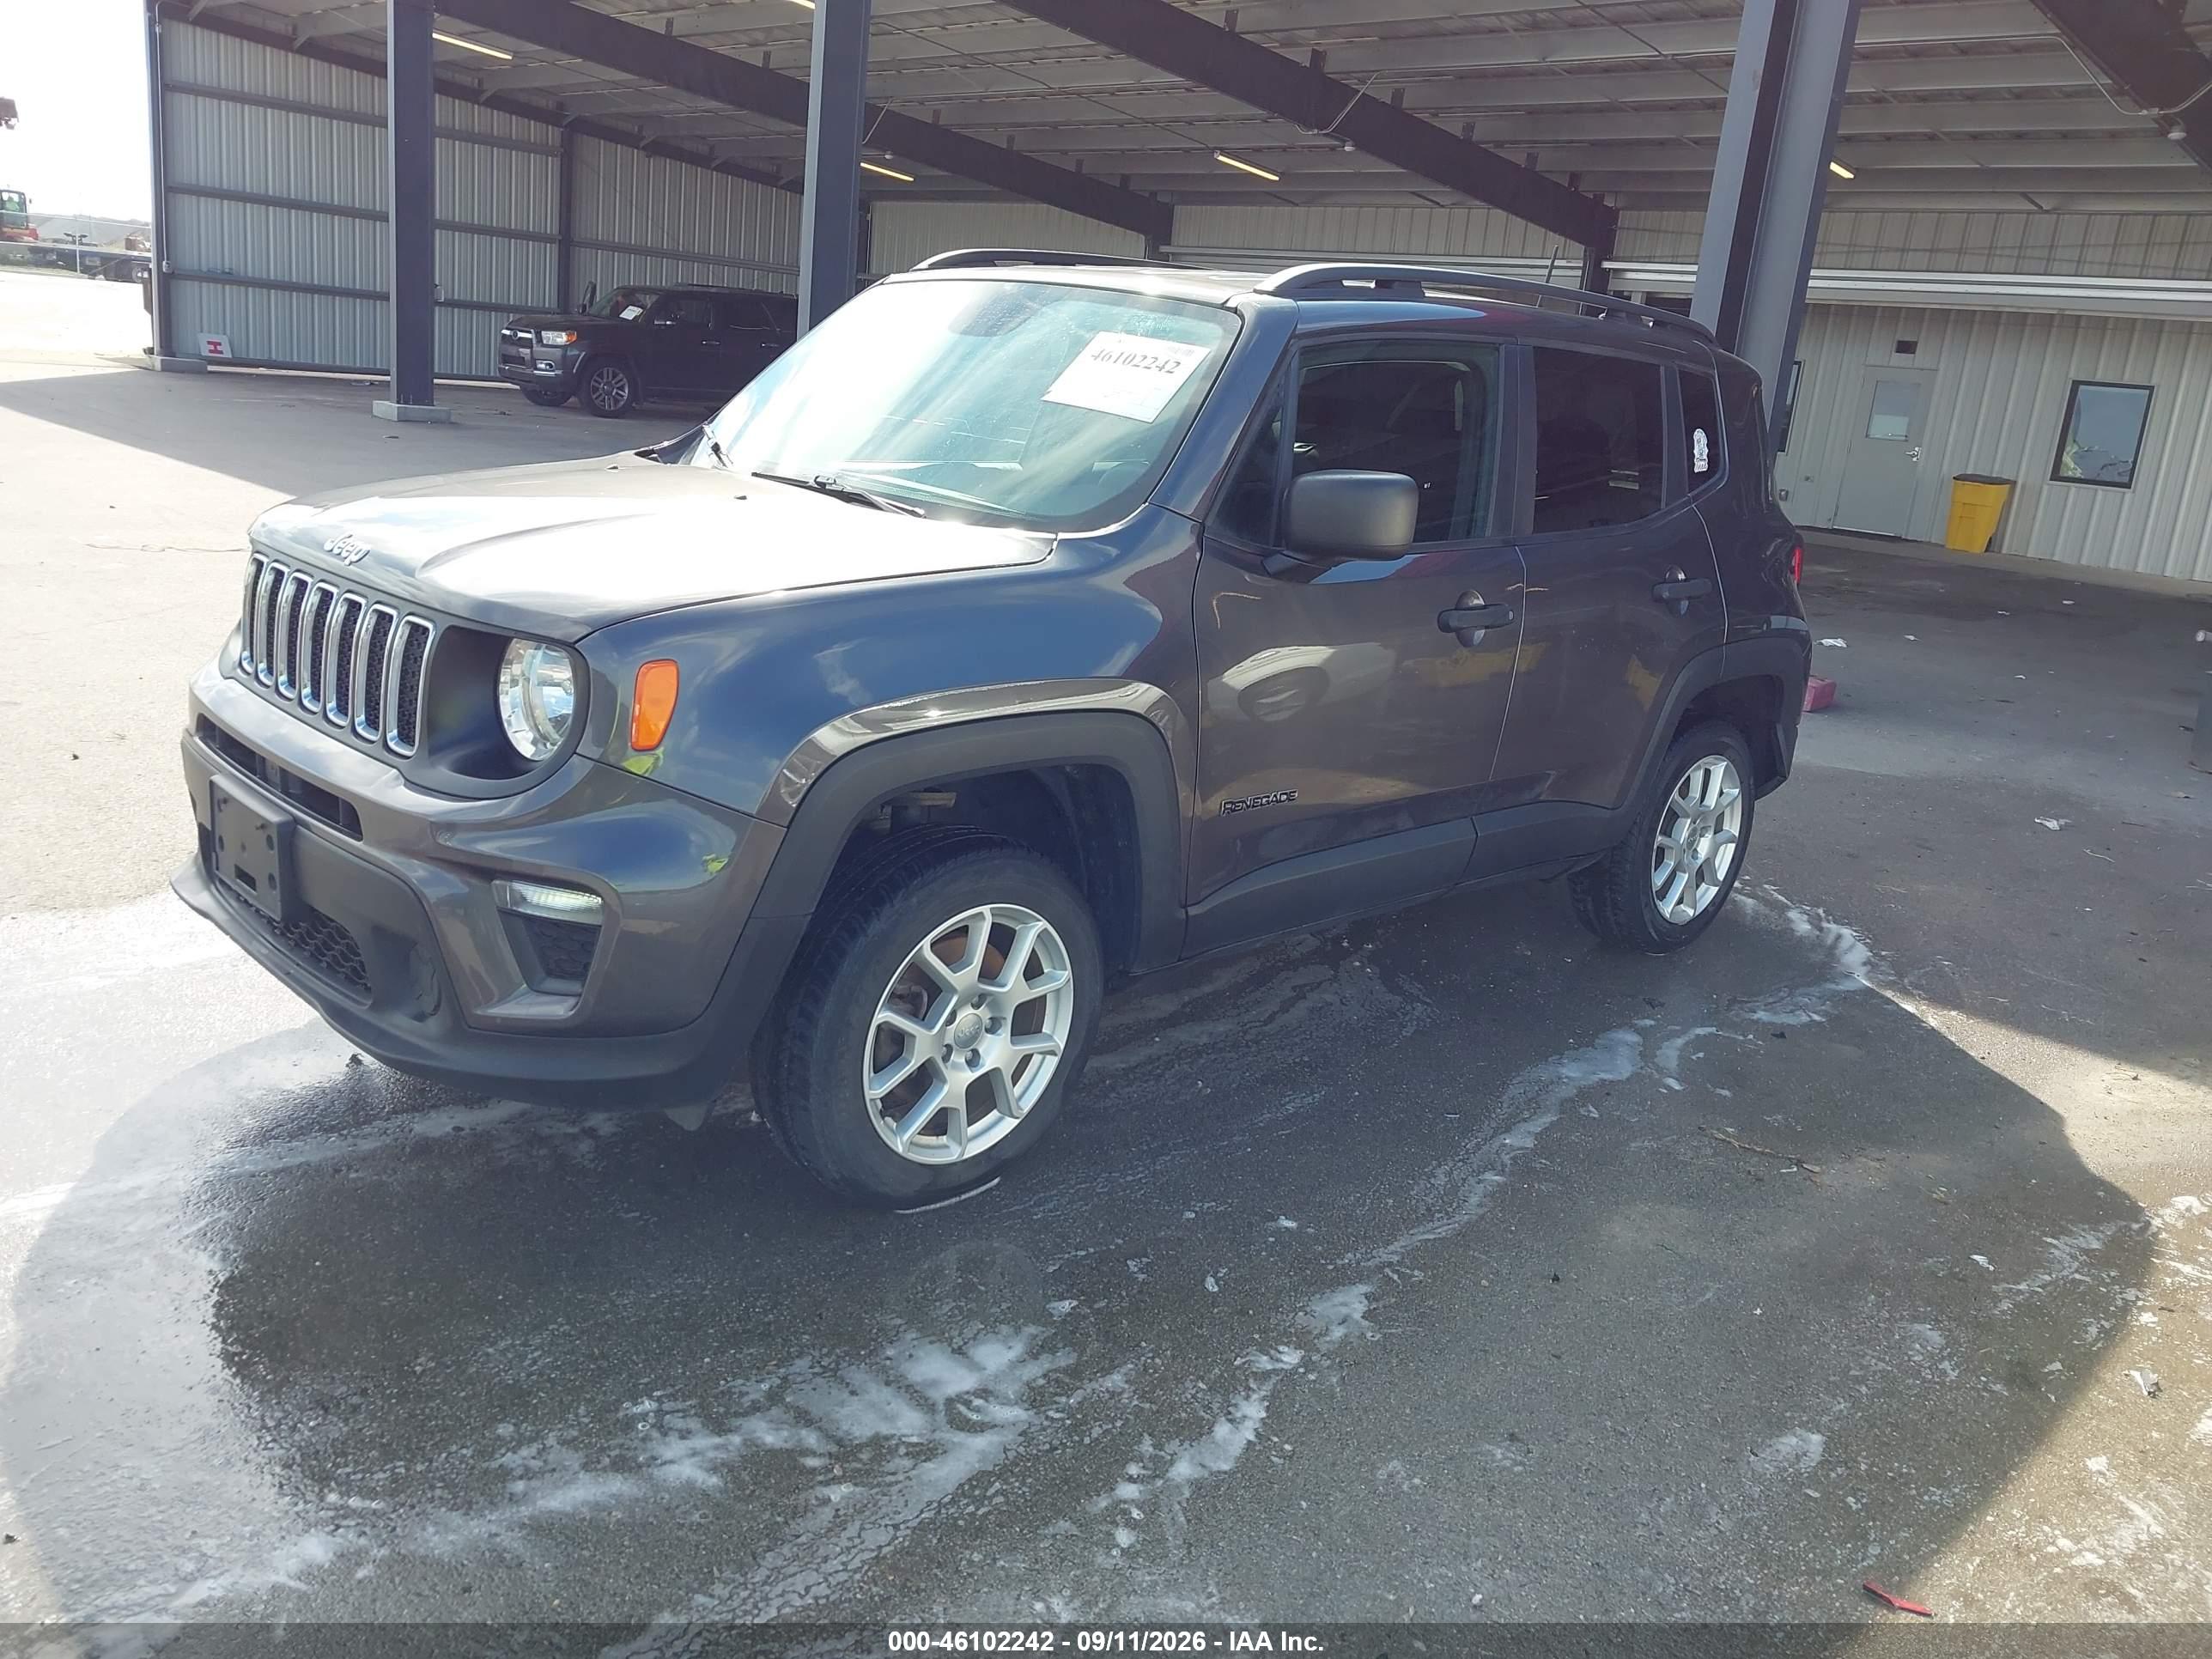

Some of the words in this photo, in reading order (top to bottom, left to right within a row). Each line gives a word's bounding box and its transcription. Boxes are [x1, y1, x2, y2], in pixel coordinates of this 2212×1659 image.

[1091, 348, 1182, 374] 46102242
[324, 533, 371, 566] Jeep
[1220, 789, 1298, 816] RENEGADE
